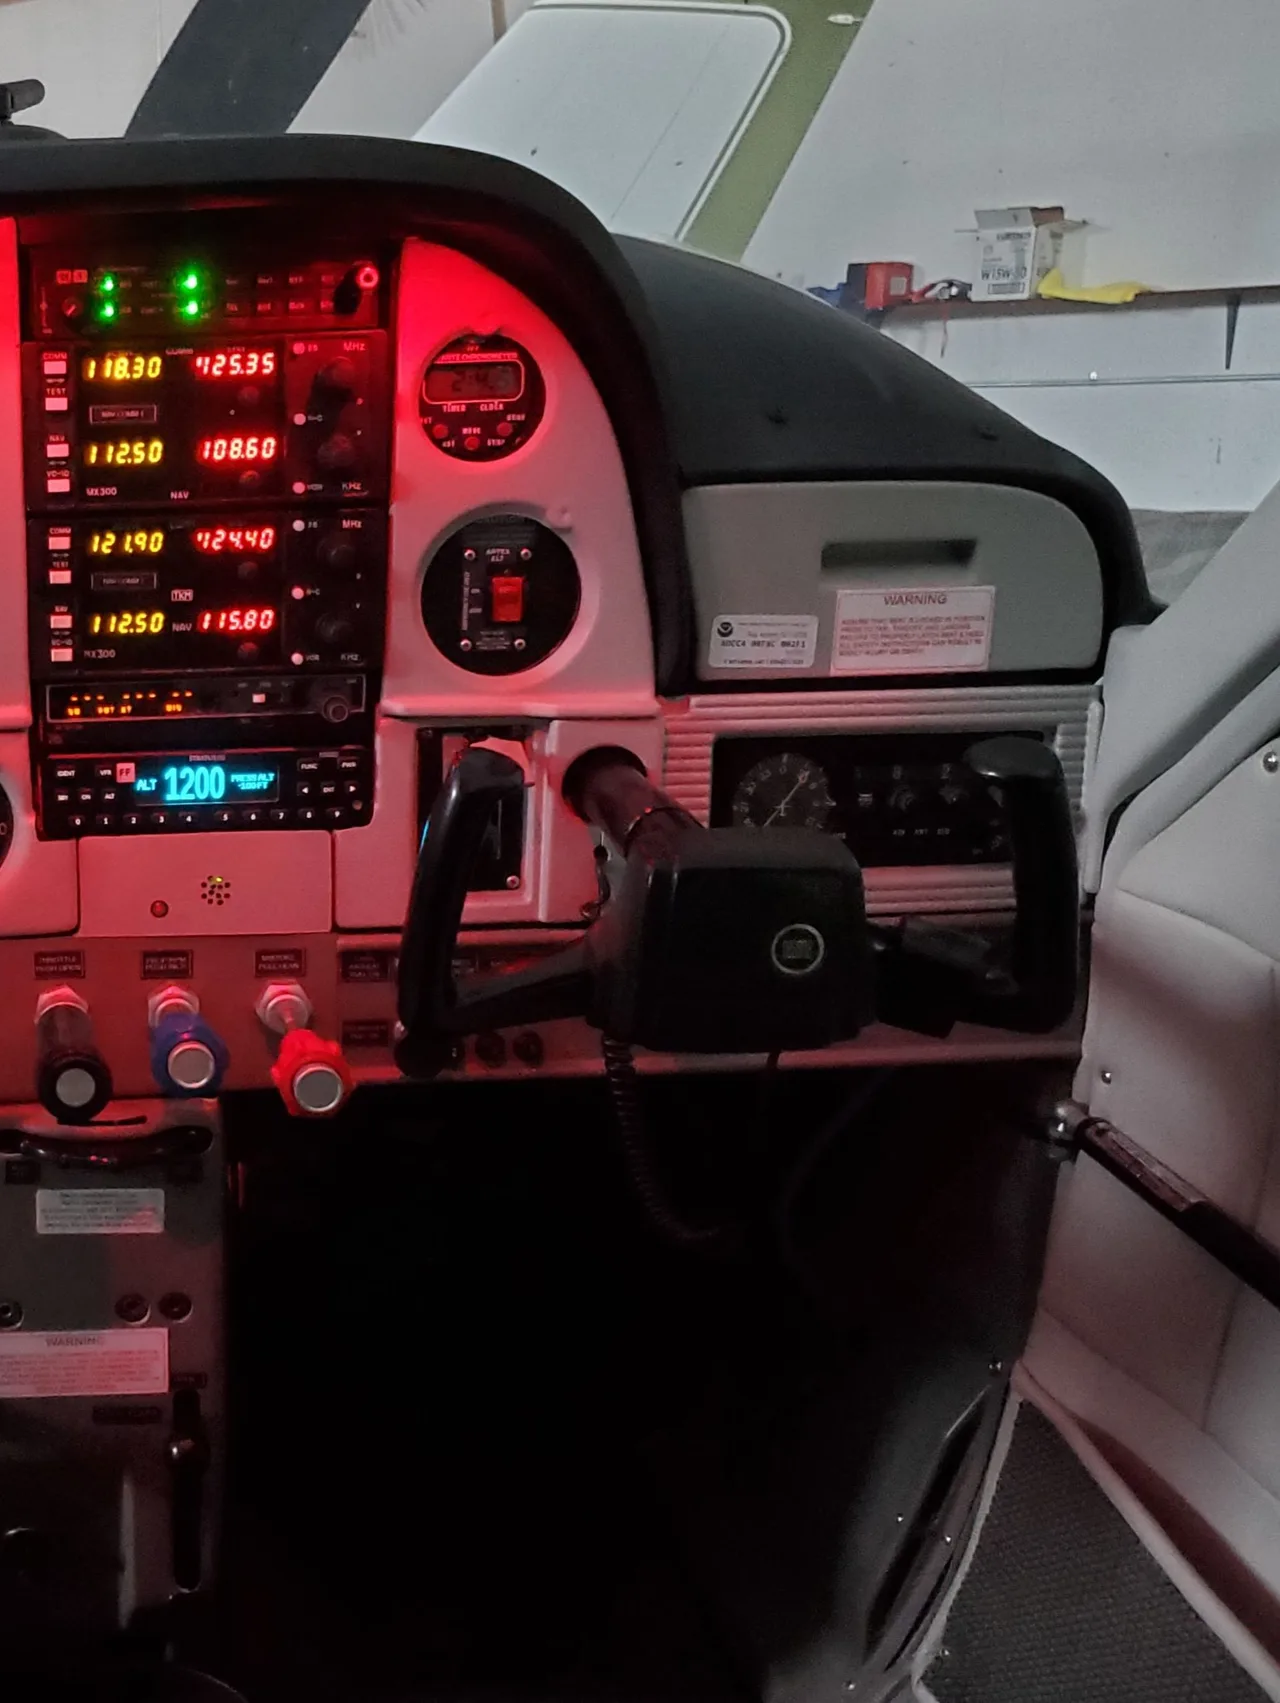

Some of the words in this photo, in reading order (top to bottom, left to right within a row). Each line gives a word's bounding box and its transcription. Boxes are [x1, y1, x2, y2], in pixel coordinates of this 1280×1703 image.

[88, 356, 162, 379] 118.30
[90, 440, 163, 464] 112.50
[203, 437, 276, 460] 108.60
[170, 491, 189, 500] NAV
[92, 531, 164, 554] 121.90
[171, 590, 193, 601] TKM
[884, 593, 947, 605] WARNING
[93, 612, 165, 634] 112.50
[202, 609, 274, 631] 115.80
[172, 623, 192, 632] NAV
[258, 772, 275, 782] ALT
[136, 779, 158, 791] ALT
[165, 766, 226, 802] 1200
[250, 813, 256, 821] 6
[279, 812, 285, 820] 7
[306, 811, 312, 819] 8
[334, 810, 341, 818] 9
[75, 818, 81, 826] 0
